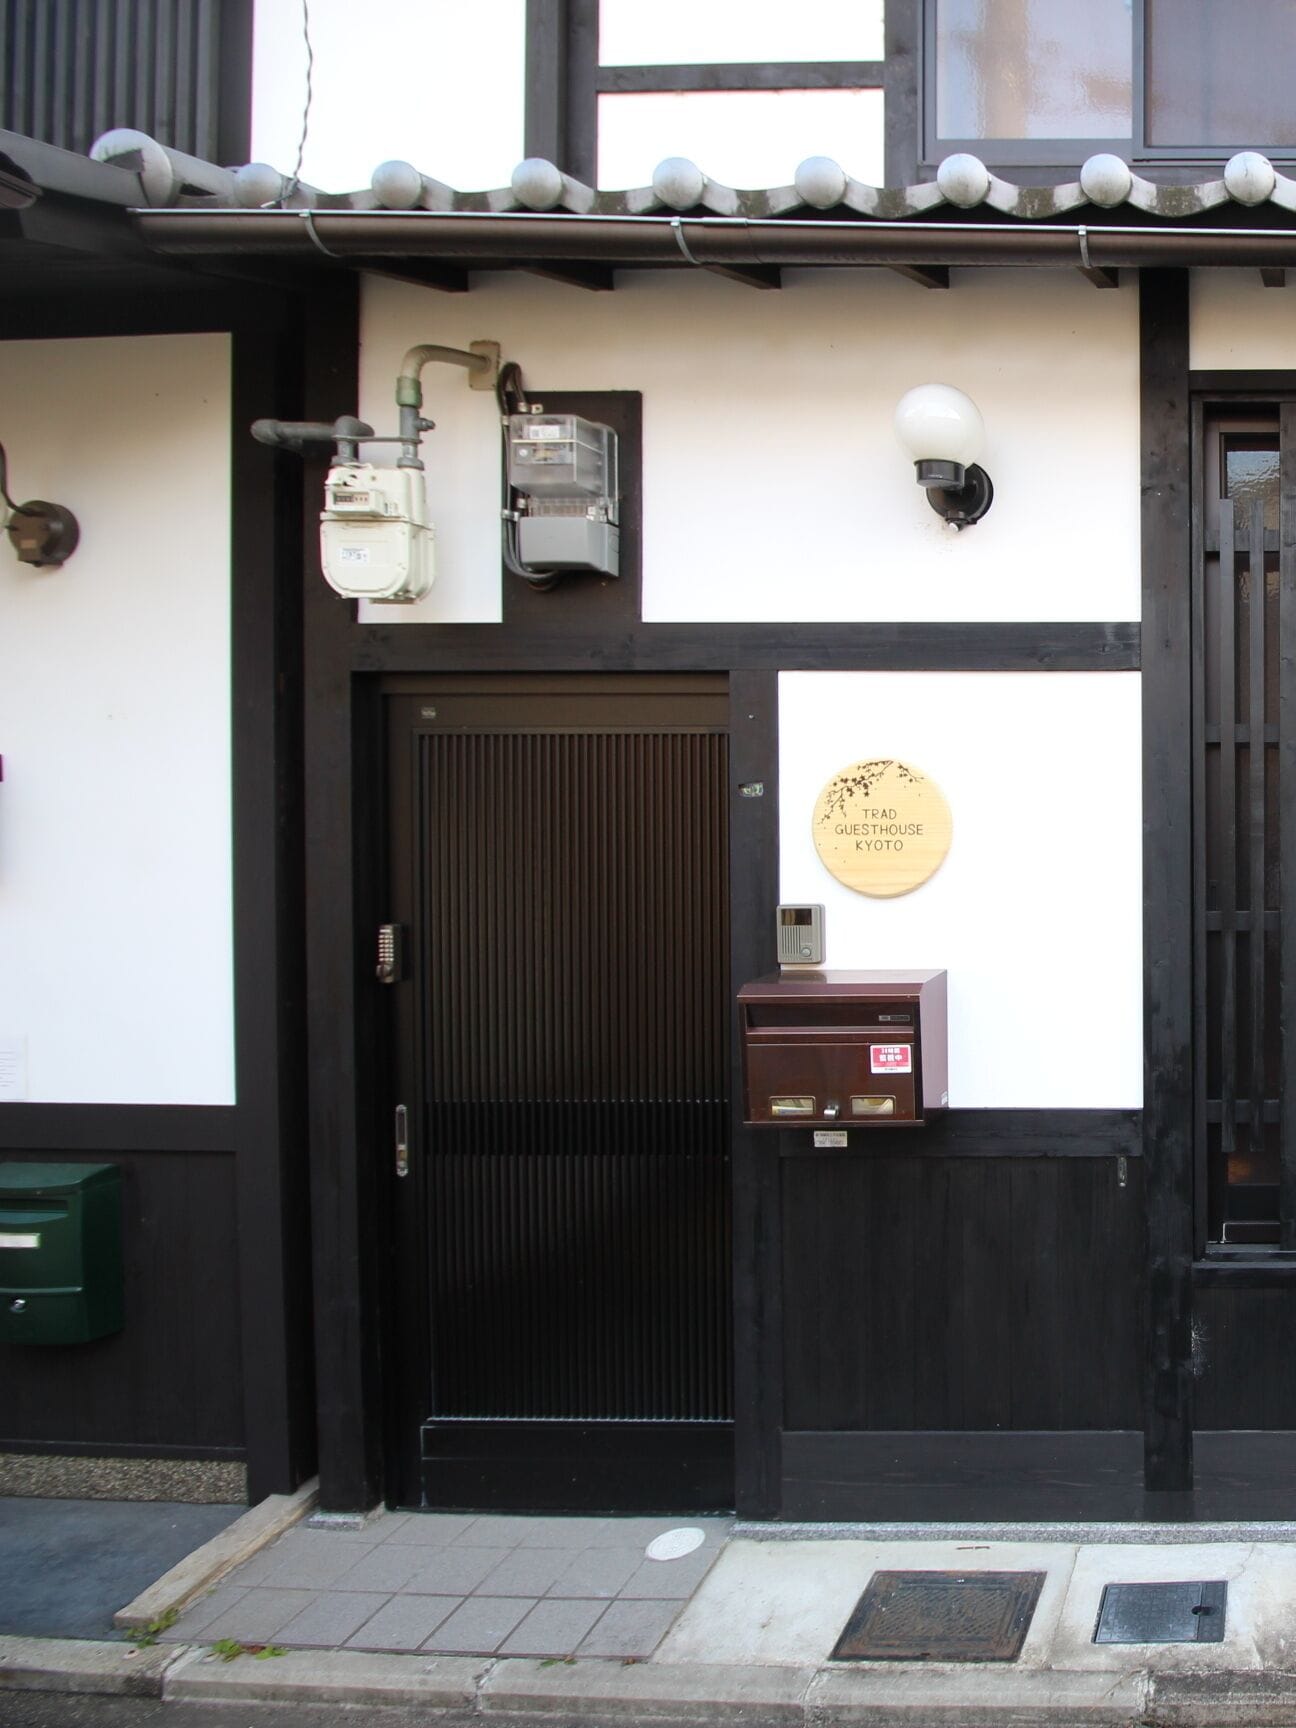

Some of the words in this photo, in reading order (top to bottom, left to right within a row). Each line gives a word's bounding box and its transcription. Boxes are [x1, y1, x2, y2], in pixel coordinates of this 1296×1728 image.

[862, 808, 897, 820] TRAD
[835, 823, 924, 836] GUESTHOUSE
[855, 839, 904, 852] KYOTO
